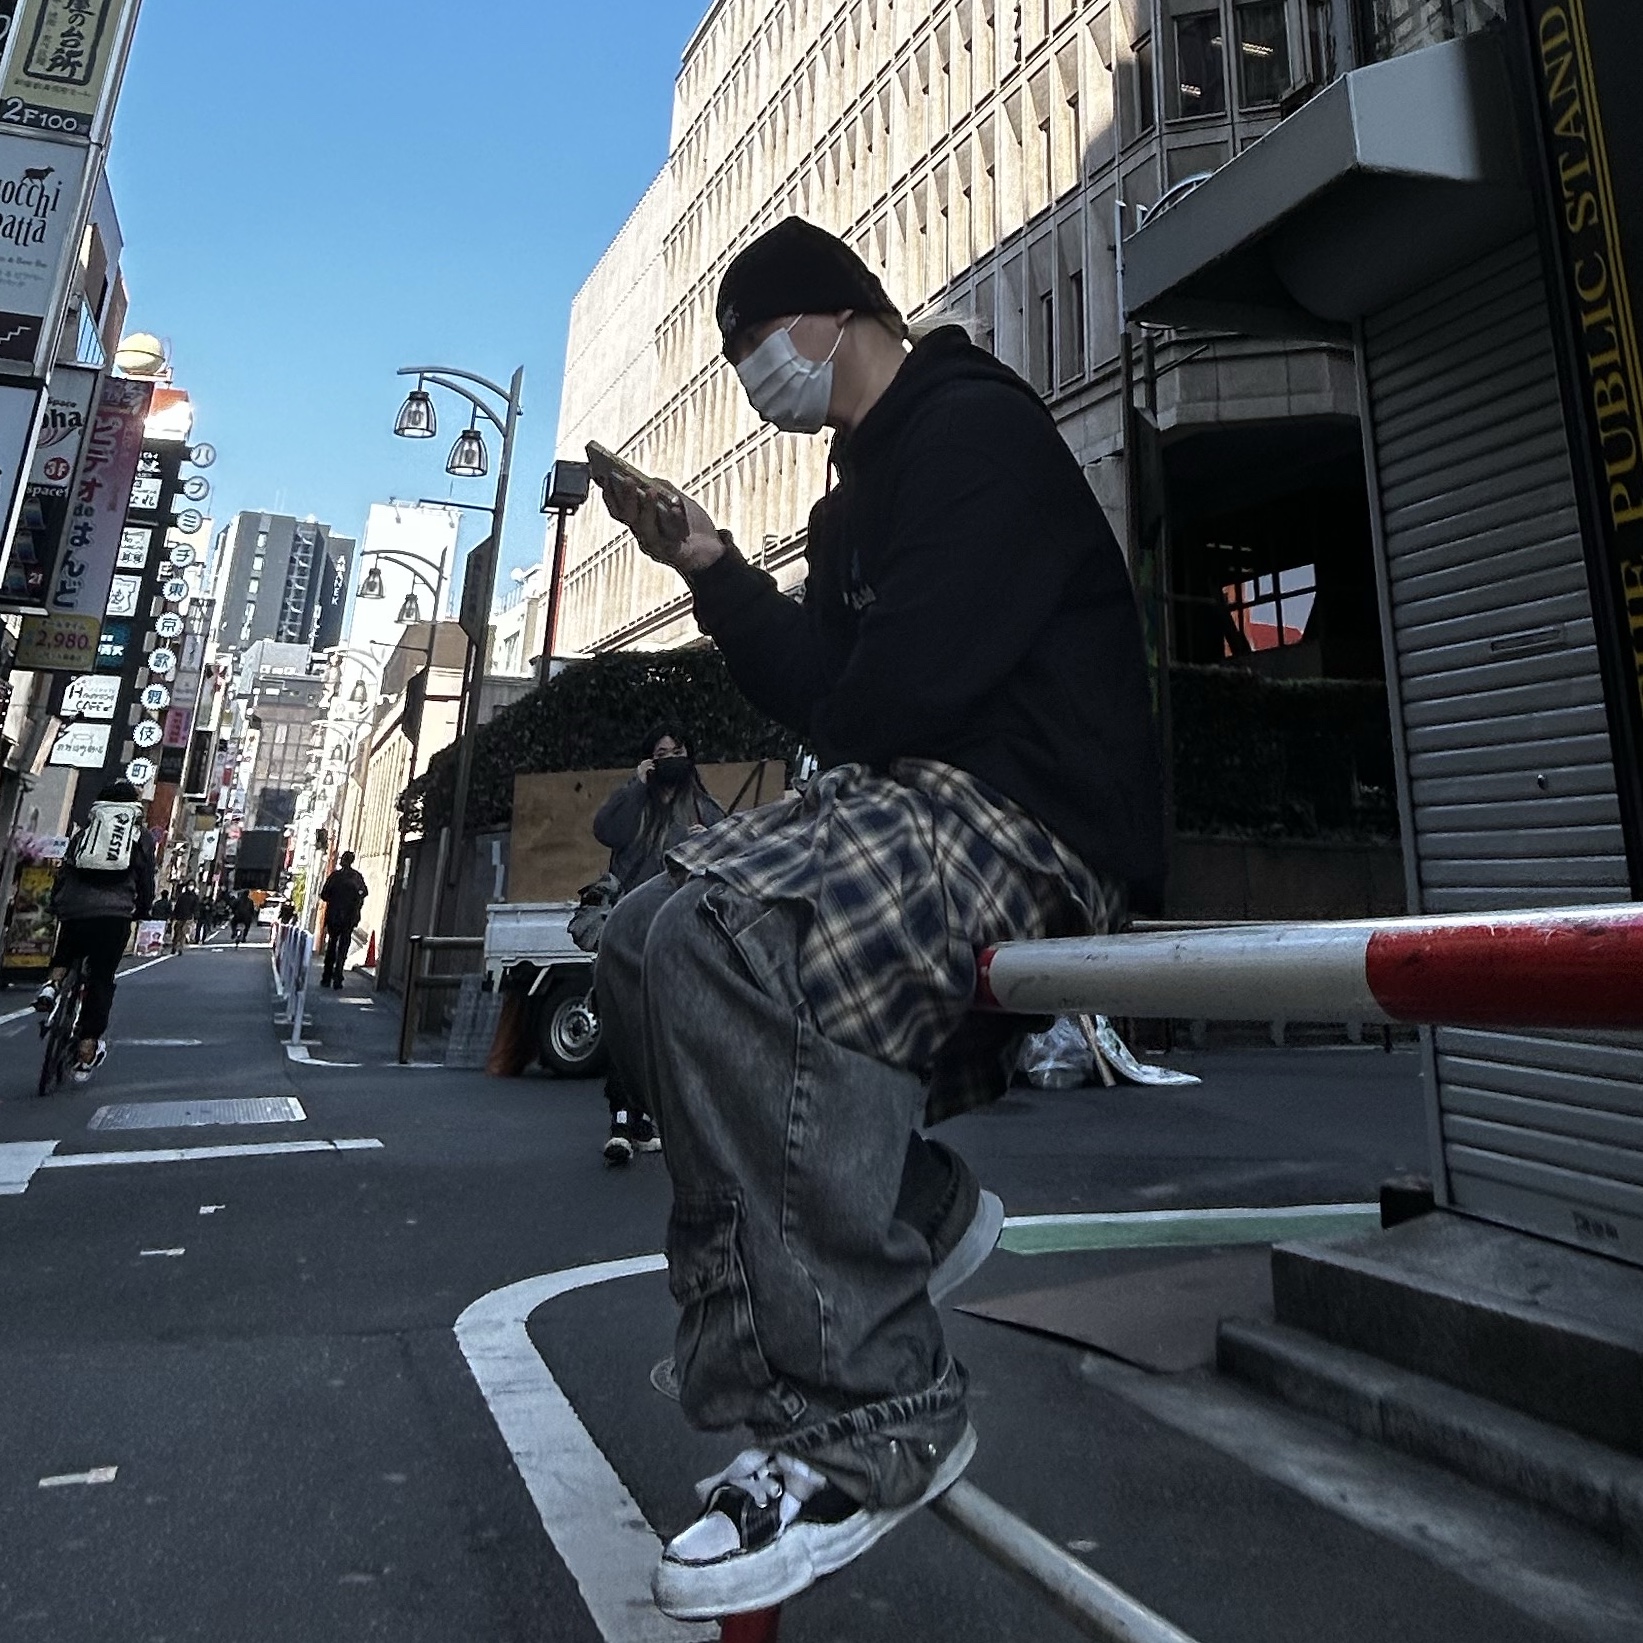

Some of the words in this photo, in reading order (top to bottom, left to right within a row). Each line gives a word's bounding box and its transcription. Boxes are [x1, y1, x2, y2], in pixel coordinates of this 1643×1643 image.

[1538, 5, 1599, 235] STAND
[0, 180, 62, 218] occhi
[0, 212, 47, 247] atta
[1575, 251, 1643, 532] PUBLIC
[46, 461, 68, 477] 3F
[36, 630, 89, 650] 2,980
